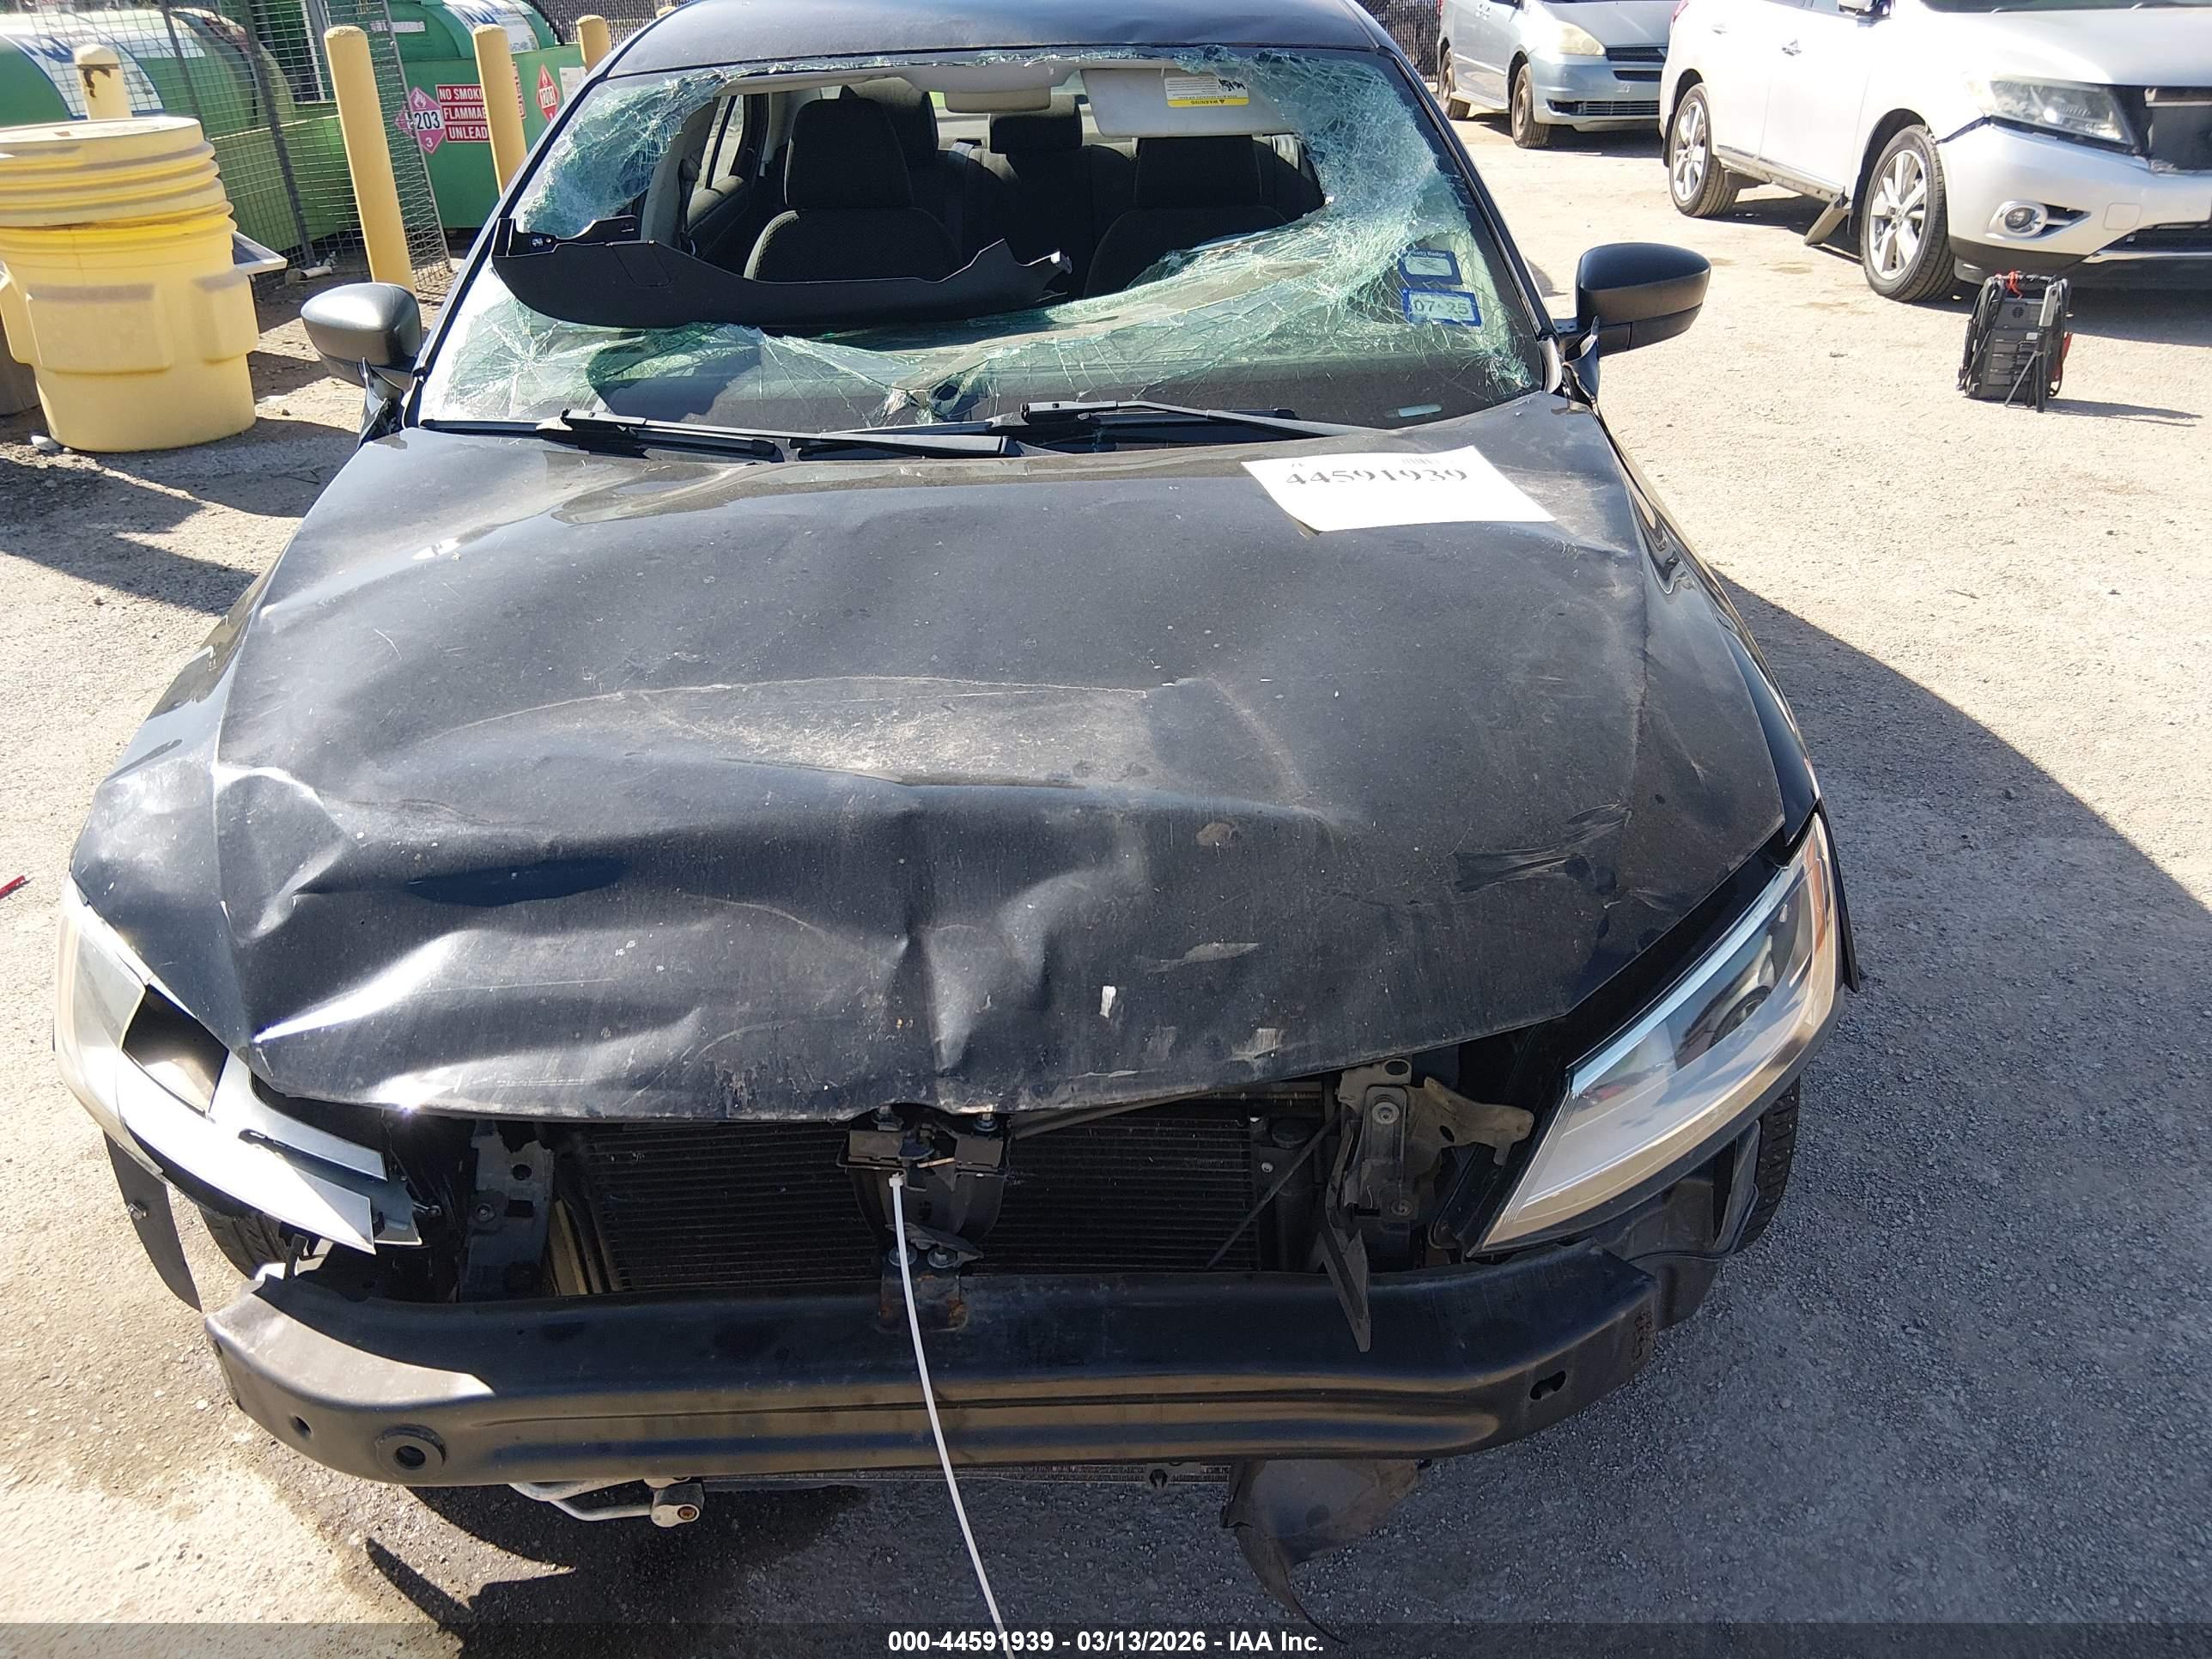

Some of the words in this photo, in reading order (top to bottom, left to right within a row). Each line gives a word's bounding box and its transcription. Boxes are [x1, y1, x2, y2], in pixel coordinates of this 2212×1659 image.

[439, 88, 452, 100] NO
[425, 137, 434, 147] 3
[1286, 470, 1468, 483] 44591939
